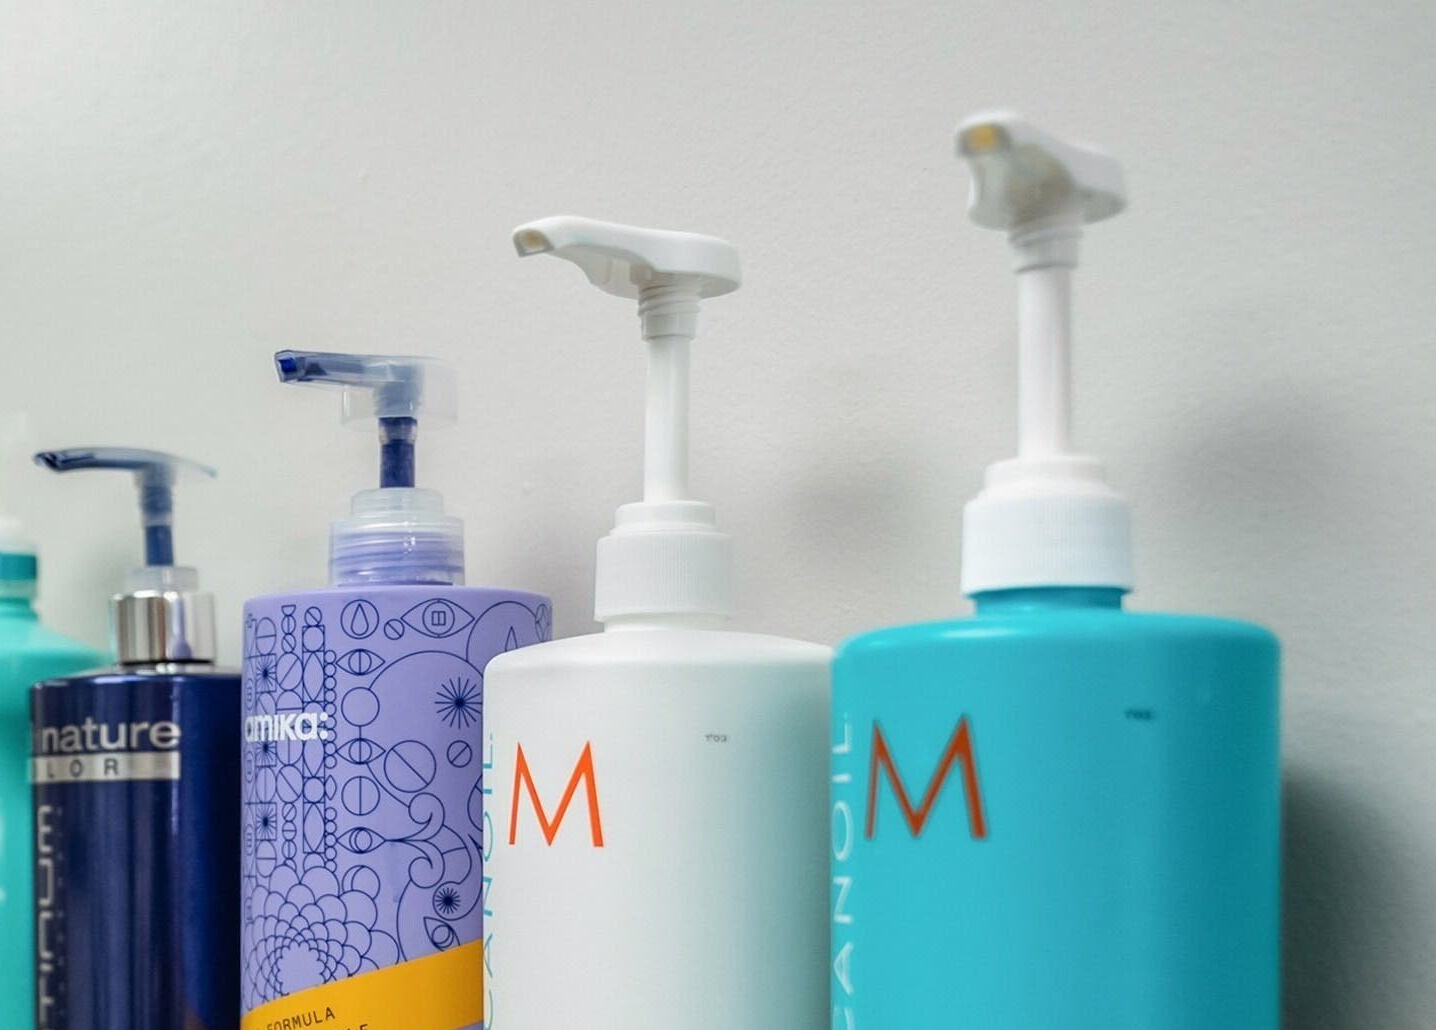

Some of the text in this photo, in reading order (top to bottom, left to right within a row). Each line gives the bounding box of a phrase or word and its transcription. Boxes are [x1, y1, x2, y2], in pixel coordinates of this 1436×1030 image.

[41, 717, 182, 752] nature
[865, 713, 989, 841] M
[507, 740, 605, 848] M
